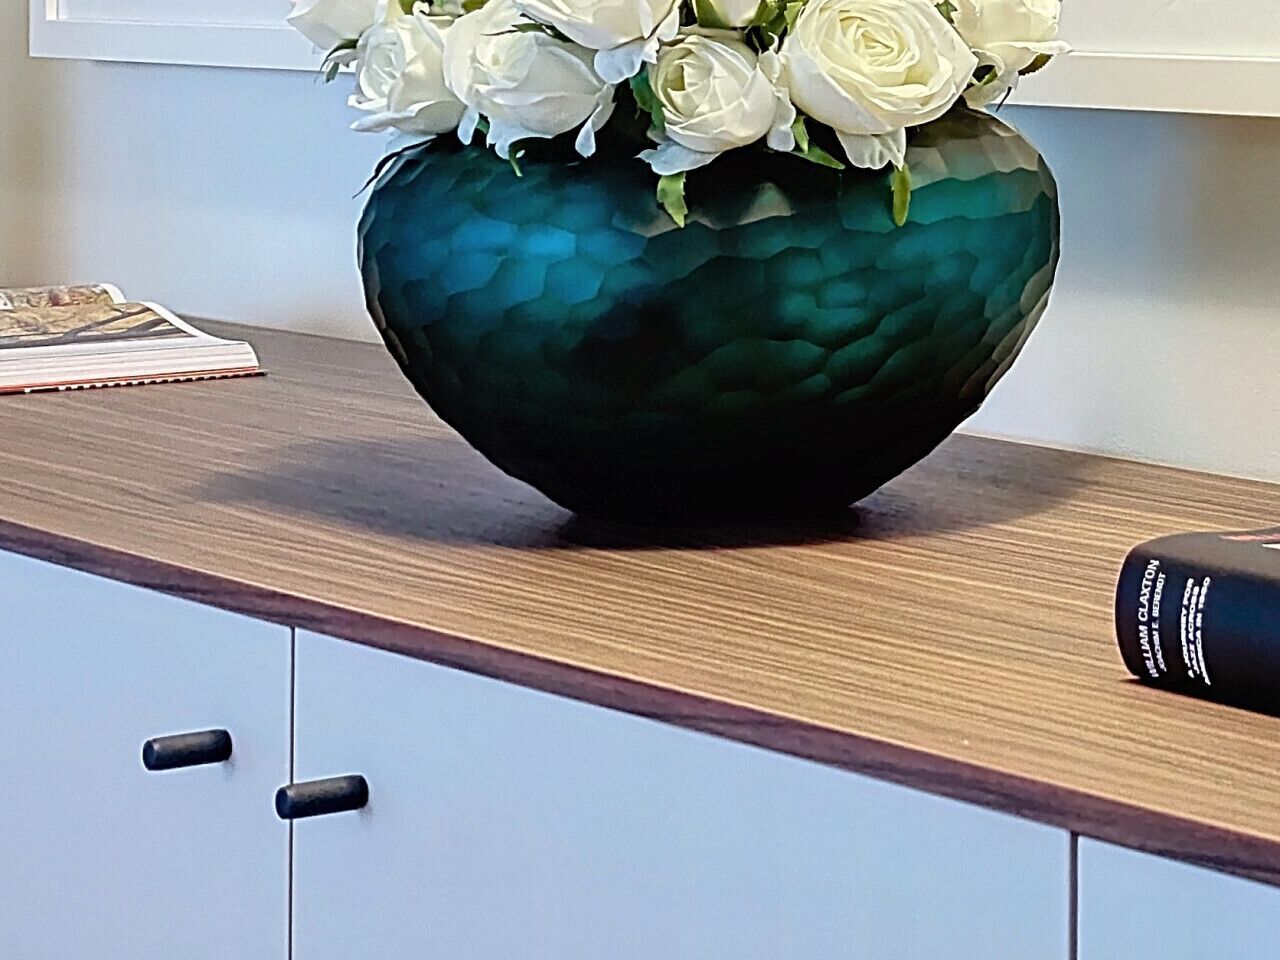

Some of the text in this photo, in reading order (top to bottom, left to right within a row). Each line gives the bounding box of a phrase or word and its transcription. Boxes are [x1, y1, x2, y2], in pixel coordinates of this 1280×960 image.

[1151, 571, 1166, 617] BERENDT
[1137, 559, 1160, 678] WILLIAM CLAXTON
[1151, 630, 1167, 673] JOACHIM
